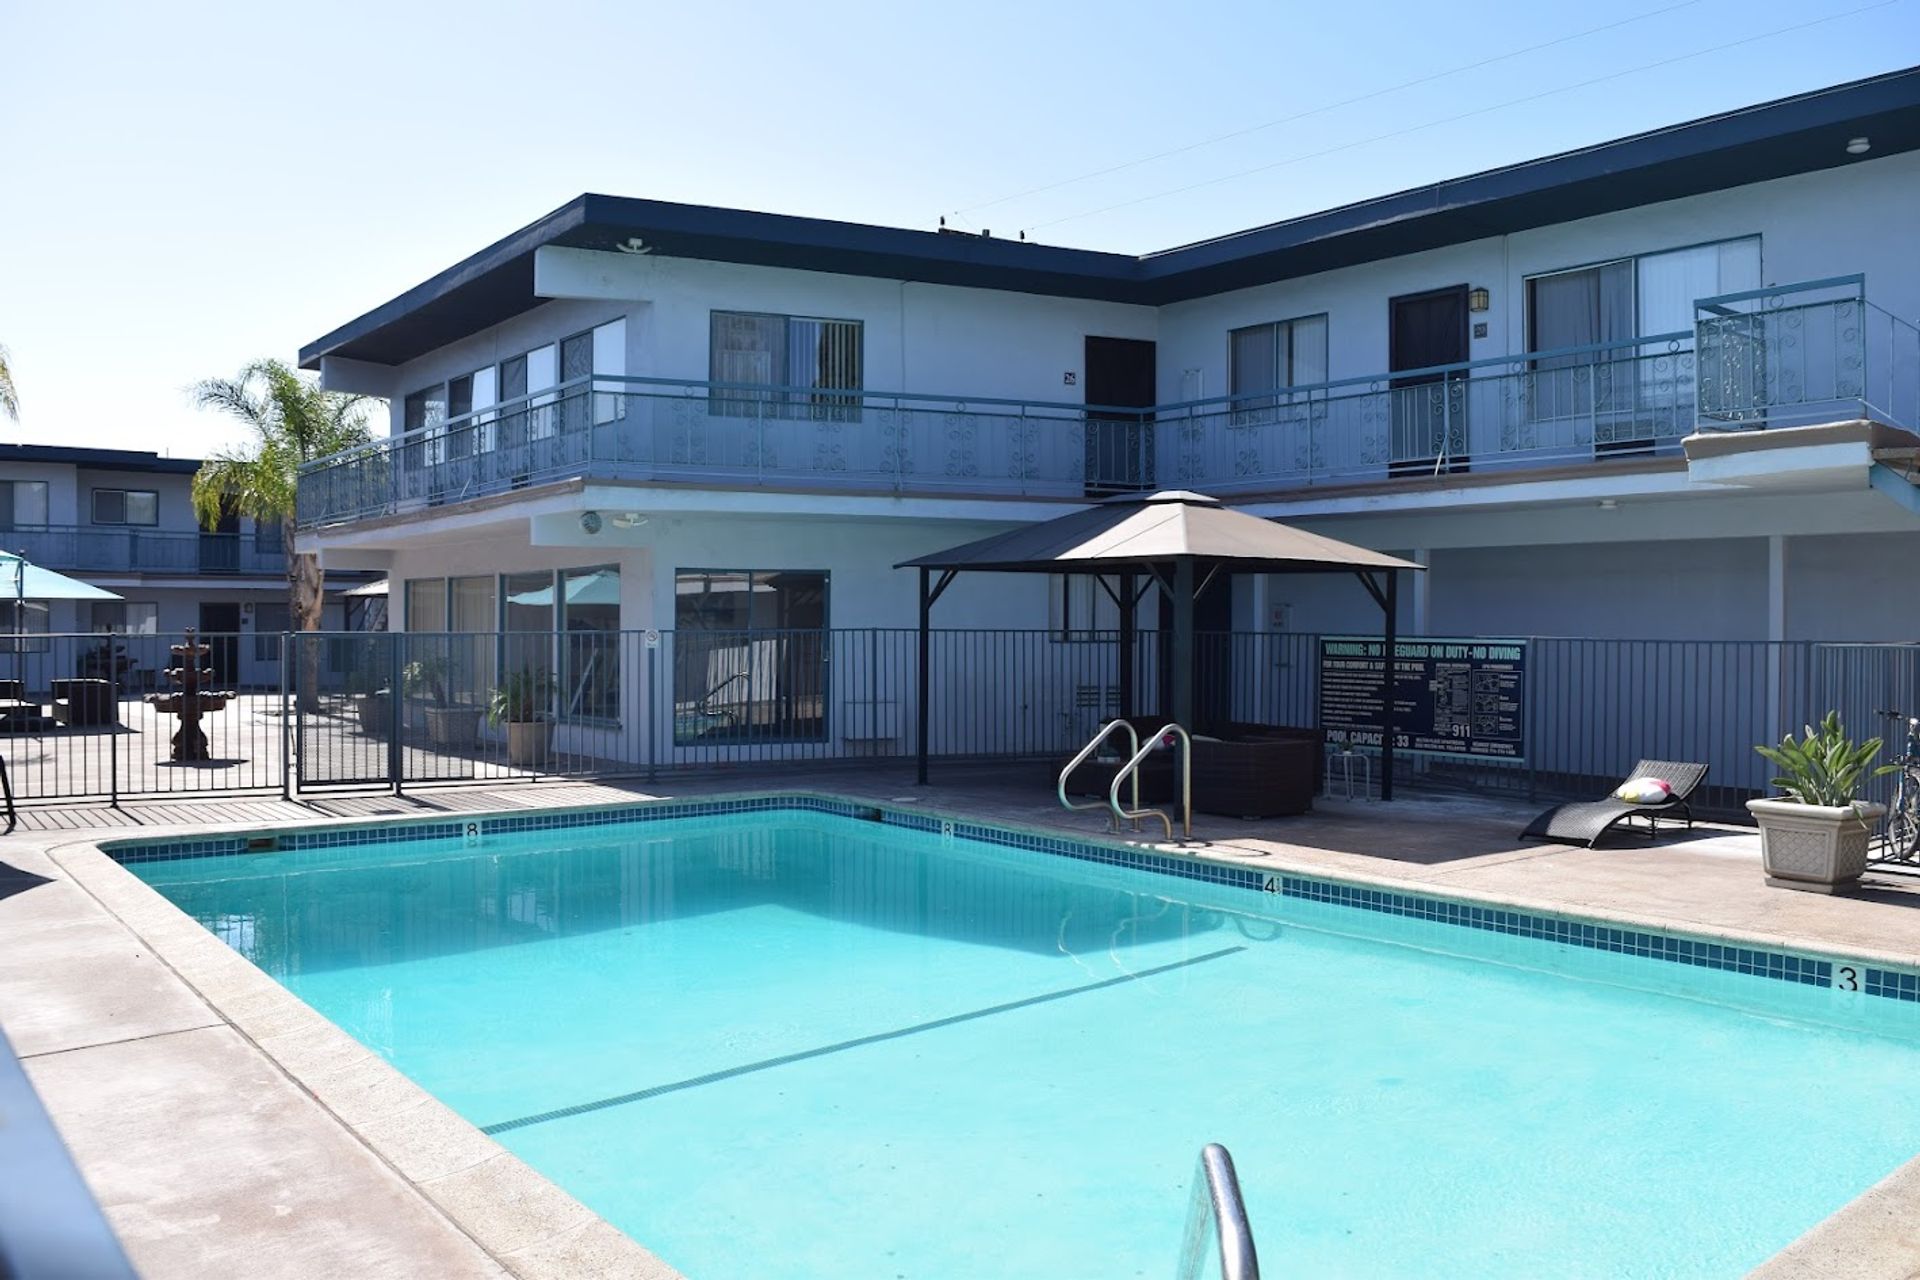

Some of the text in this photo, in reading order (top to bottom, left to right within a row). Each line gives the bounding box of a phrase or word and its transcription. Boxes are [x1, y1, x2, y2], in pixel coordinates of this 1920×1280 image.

[1325, 642, 1367, 656] WARNING:
[1368, 644, 1381, 657] NO
[1430, 645, 1443, 658] ON
[1489, 646, 1521, 661] DIVING
[1327, 730, 1348, 743] POOL
[1396, 735, 1409, 747] 33
[1452, 725, 1471, 738] 911
[467, 823, 478, 837] 8
[1264, 876, 1276, 893] 4
[1839, 967, 1858, 992] 3
